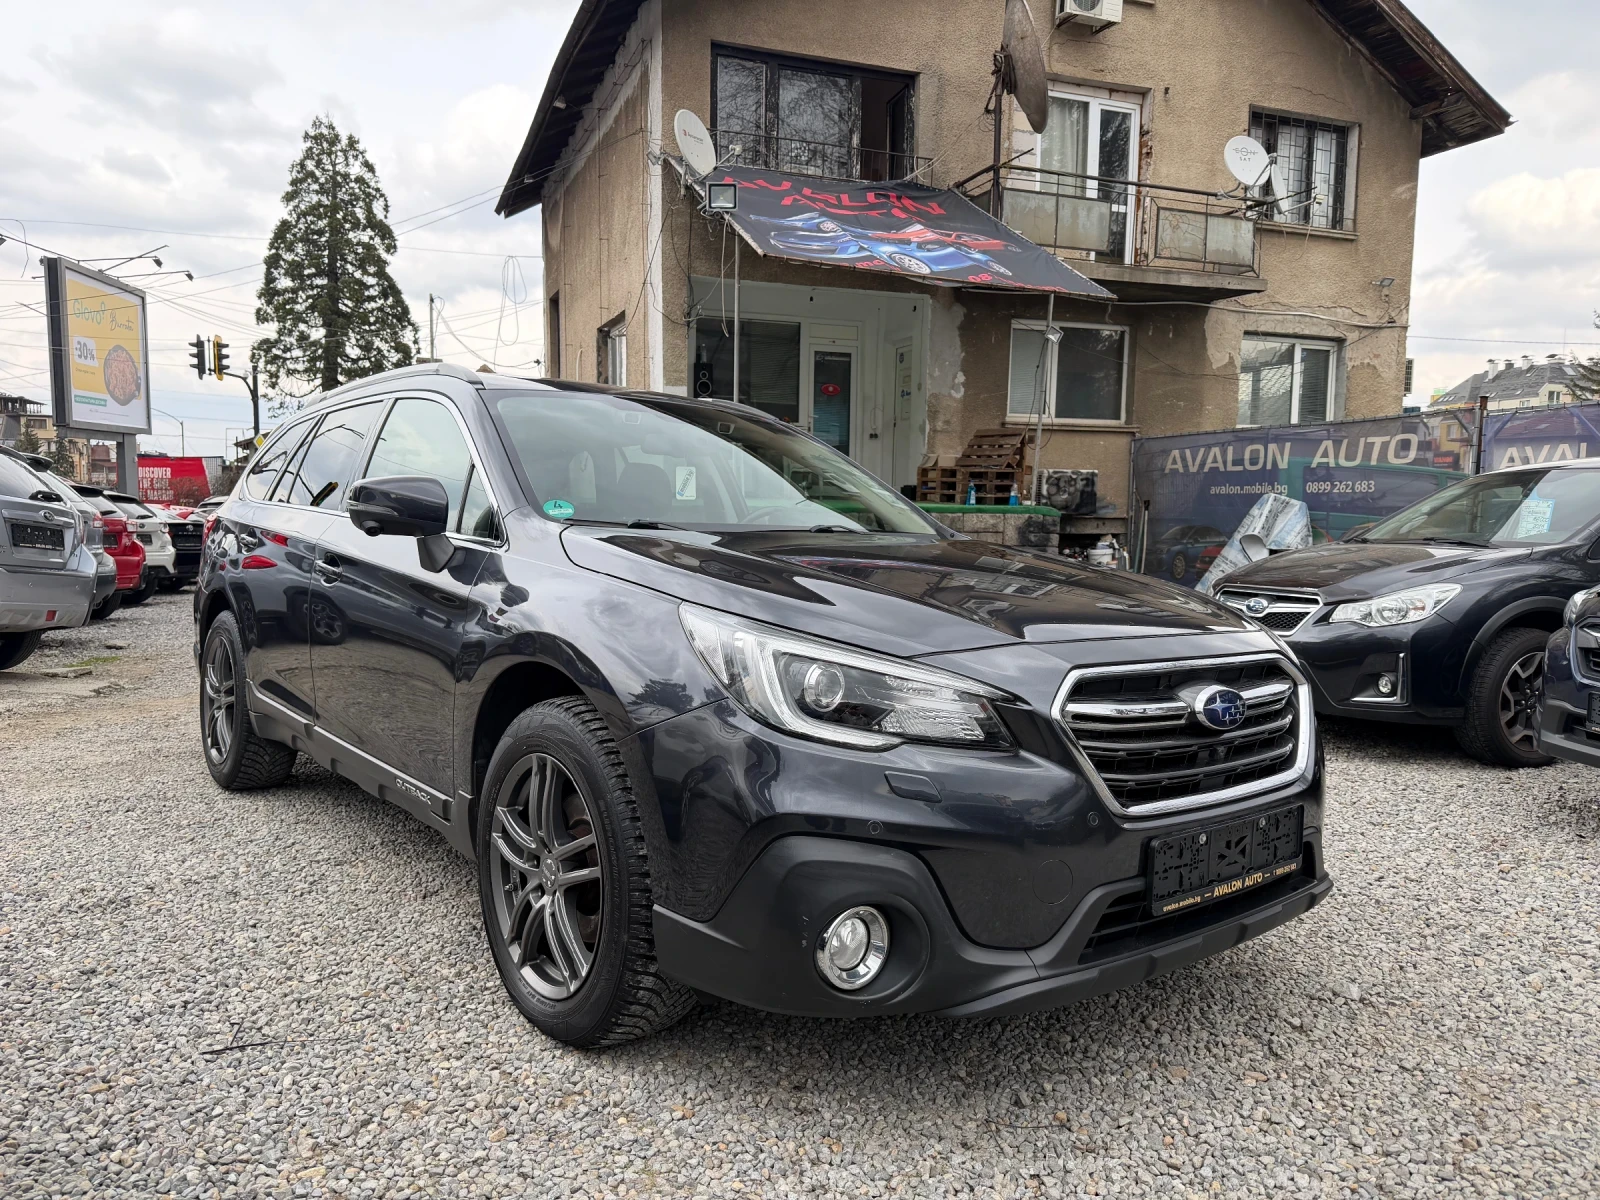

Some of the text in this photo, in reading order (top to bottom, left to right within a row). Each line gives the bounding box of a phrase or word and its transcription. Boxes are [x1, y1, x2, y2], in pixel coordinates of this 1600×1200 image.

[1164, 433, 1419, 473] AVALON AUTO
[138, 467, 171, 478] DISCOVER
[1210, 480, 1375, 496] avalon.mobile.bg 0899 262 683
[1213, 878, 1243, 898] AVALON
[1244, 872, 1264, 888] AUTO
